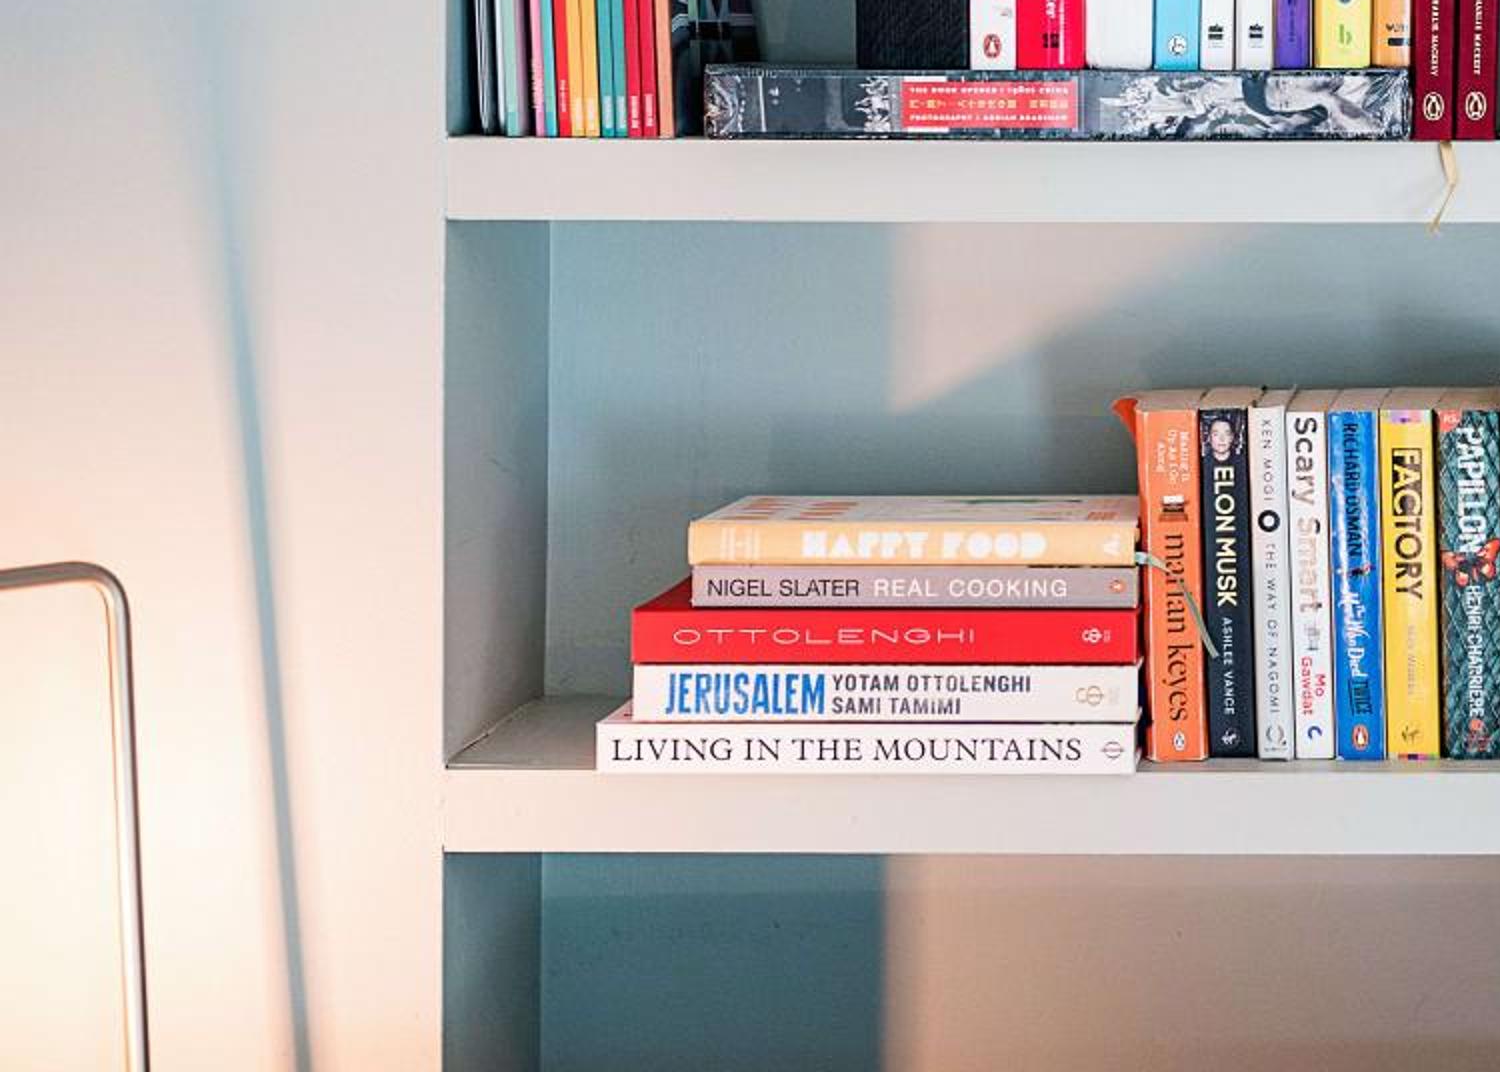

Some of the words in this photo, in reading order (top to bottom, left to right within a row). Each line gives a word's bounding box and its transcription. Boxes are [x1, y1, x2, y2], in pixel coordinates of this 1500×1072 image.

[1263, 456, 1275, 502] MOGI
[1292, 417, 1319, 505] Scary
[1213, 466, 1236, 531] ELON
[1456, 427, 1487, 553] PAPILLON
[802, 530, 928, 559] HAPPY
[942, 530, 1047, 559] FOOD
[1346, 495, 1363, 558] OSMAN
[1391, 447, 1423, 600] FACTORY
[707, 579, 772, 597] NIGEL
[779, 579, 860, 597] SLATER
[874, 579, 938, 597] REAL
[949, 578, 1068, 598] COOKING
[1216, 537, 1238, 608] MUSK
[1297, 517, 1323, 613] Smart
[1266, 579, 1278, 611] WAY
[673, 628, 975, 645] OTTOLENGHI
[1222, 617, 1234, 665] ASHLEE
[1267, 618, 1278, 637] OF
[1162, 643, 1195, 722] keyes
[1268, 647, 1281, 714] NAGOMI
[1347, 647, 1369, 677] Died
[665, 673, 825, 715] JERUSALEM
[832, 674, 899, 692] YOTAM
[906, 675, 1031, 693] OTTOLENGHI
[832, 697, 881, 715] SAMI
[1223, 671, 1236, 715] VANCE
[1300, 656, 1315, 715] Gawdat
[1314, 674, 1326, 697] Mo
[612, 738, 733, 761] LIVING
[744, 739, 780, 761] IN
[791, 739, 863, 761] THE
[874, 738, 1082, 761] MOUNTAINS
